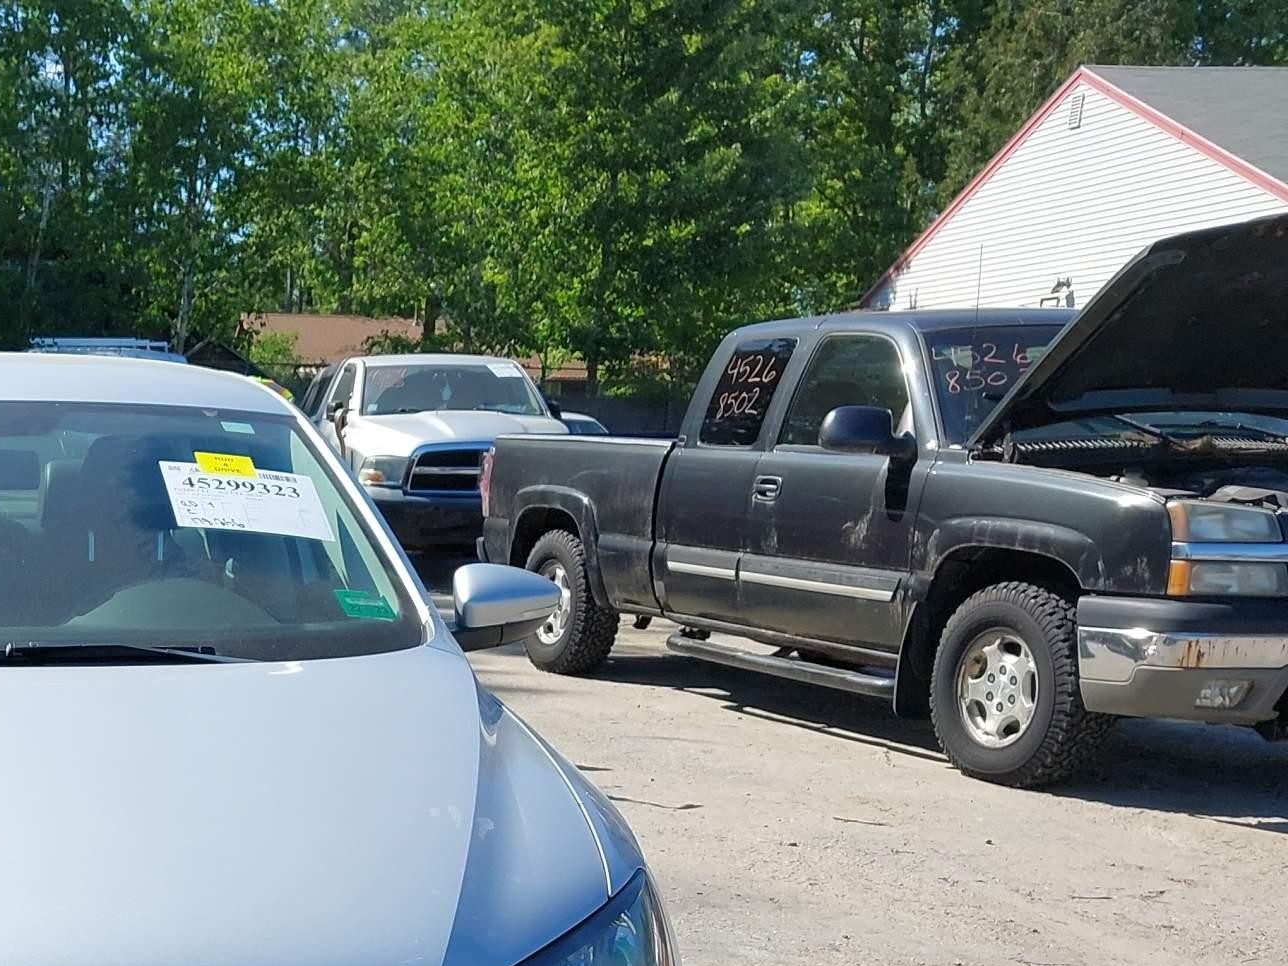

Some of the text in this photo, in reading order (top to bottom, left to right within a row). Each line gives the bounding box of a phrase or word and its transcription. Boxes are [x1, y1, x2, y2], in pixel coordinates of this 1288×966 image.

[931, 342, 1033, 367] 4526
[727, 354, 777, 385] 4526
[715, 386, 761, 420] 8502
[181, 476, 301, 499] 45299323
